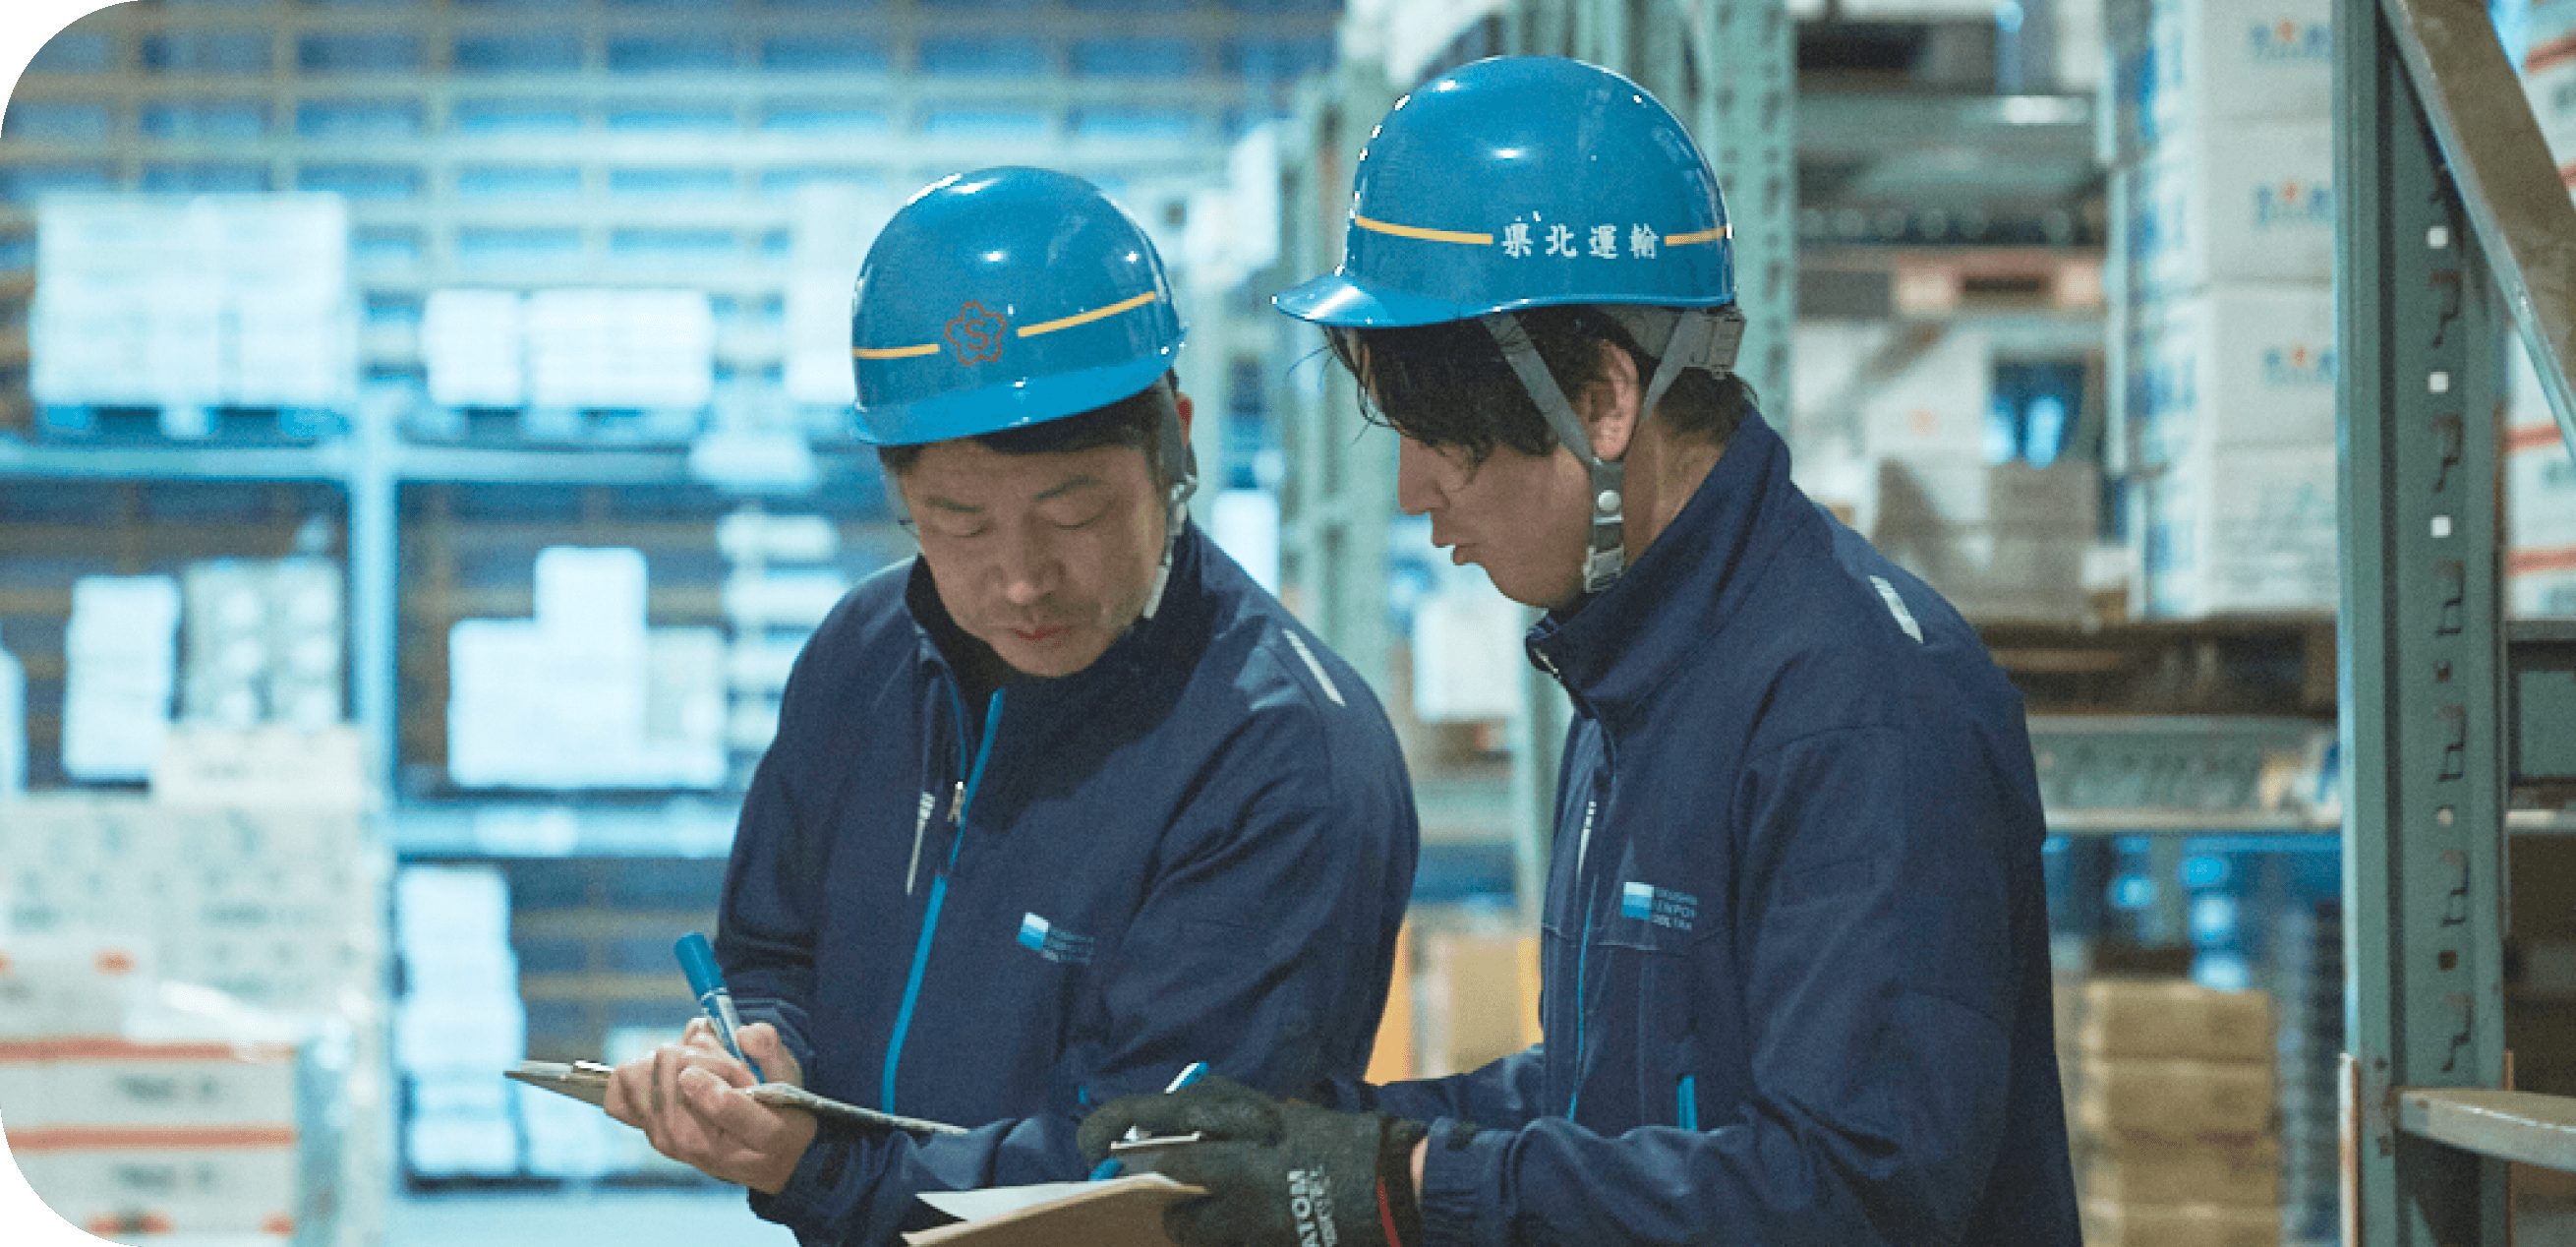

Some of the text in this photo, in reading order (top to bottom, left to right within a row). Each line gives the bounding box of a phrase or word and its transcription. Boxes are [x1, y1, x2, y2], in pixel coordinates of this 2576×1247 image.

[1500, 222, 1659, 259] 県北運輸
[1287, 1168, 1321, 1247] ATOM
